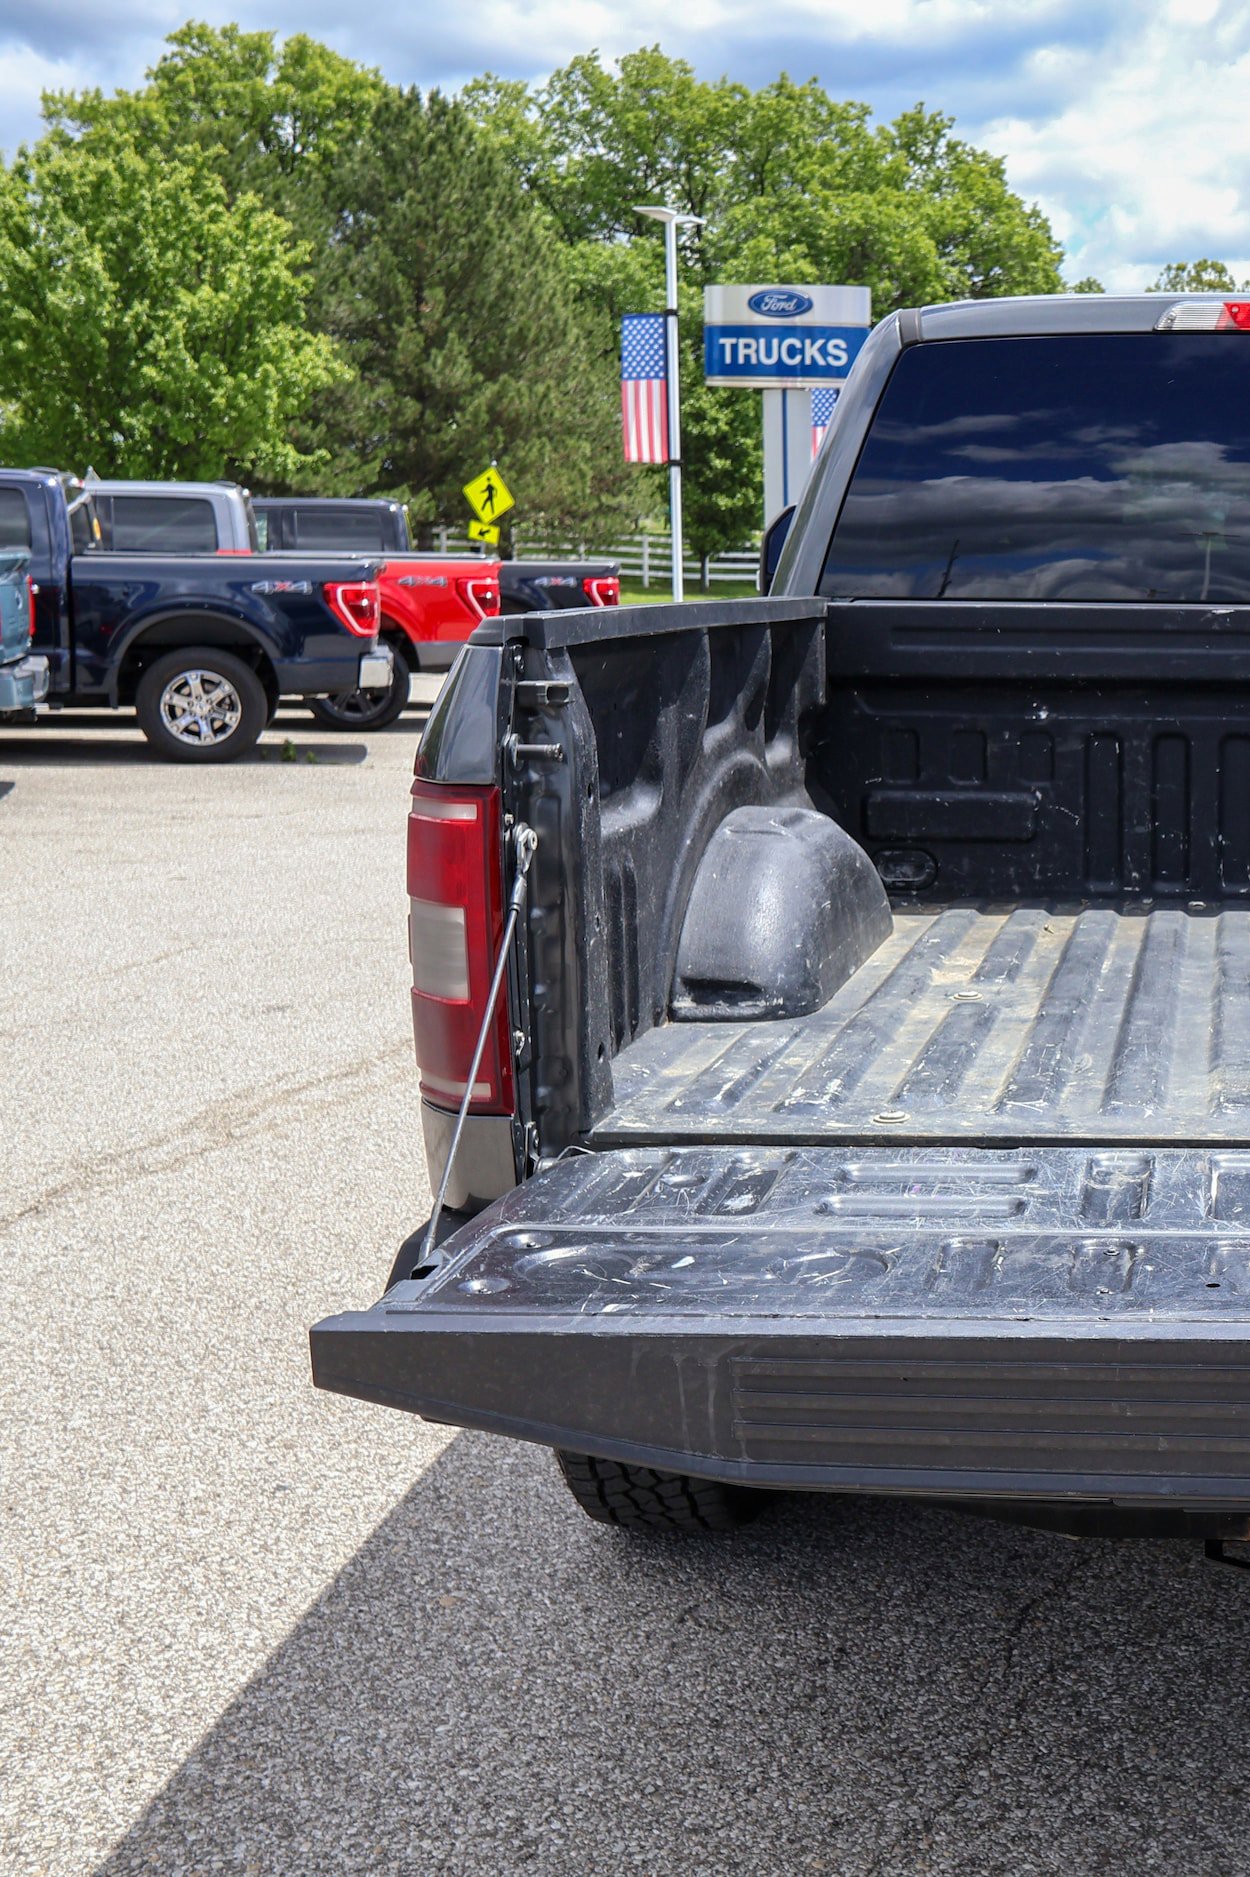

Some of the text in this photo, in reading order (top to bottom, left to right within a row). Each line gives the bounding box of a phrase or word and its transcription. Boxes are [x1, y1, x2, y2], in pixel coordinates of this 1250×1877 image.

[760, 294, 798, 312] Ford
[719, 337, 849, 367] TRUCKS
[251, 580, 313, 596] 4X4
